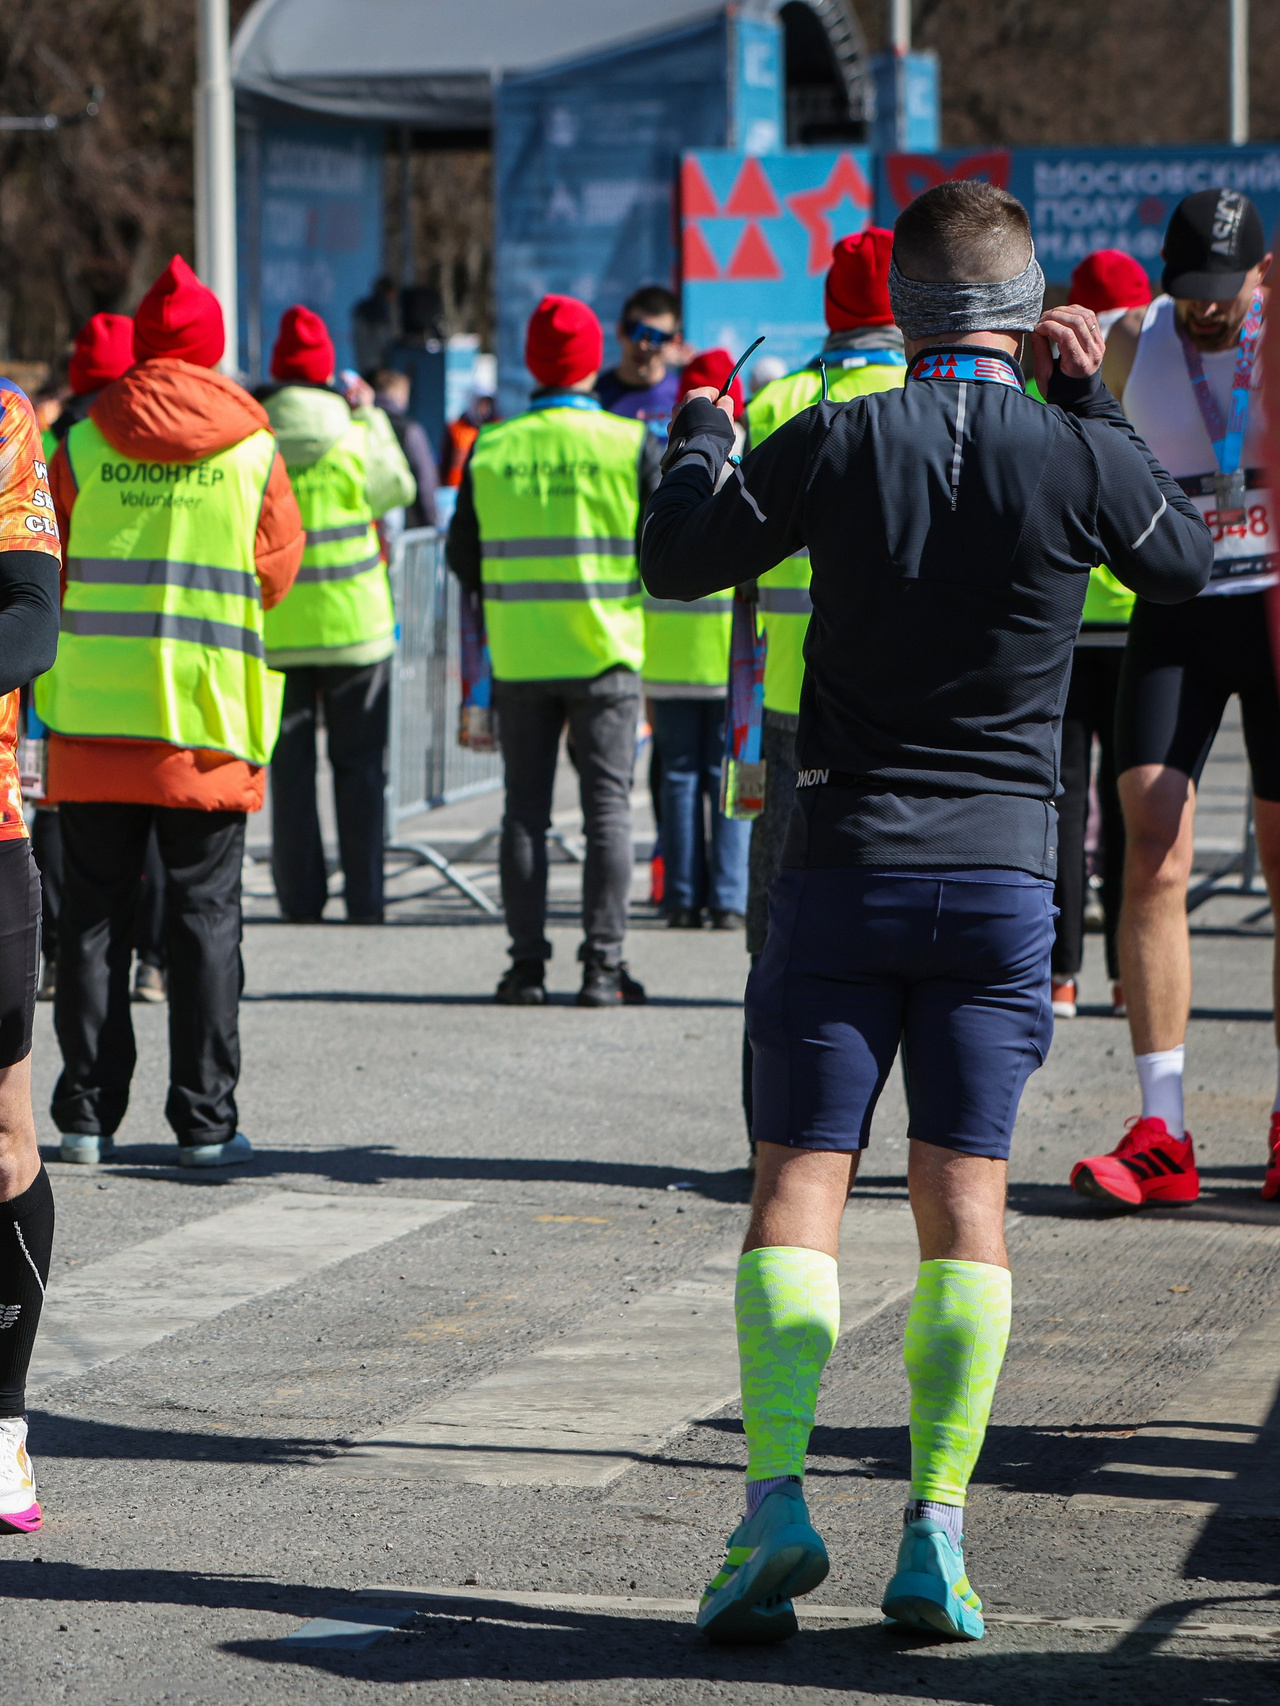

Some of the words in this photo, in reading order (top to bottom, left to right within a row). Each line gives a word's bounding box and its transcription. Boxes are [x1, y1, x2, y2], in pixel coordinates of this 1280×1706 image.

[101, 461, 224, 486] ВОЛОНТЁР
[120, 491, 203, 508] Volunteer
[795, 768, 830, 788] MON
